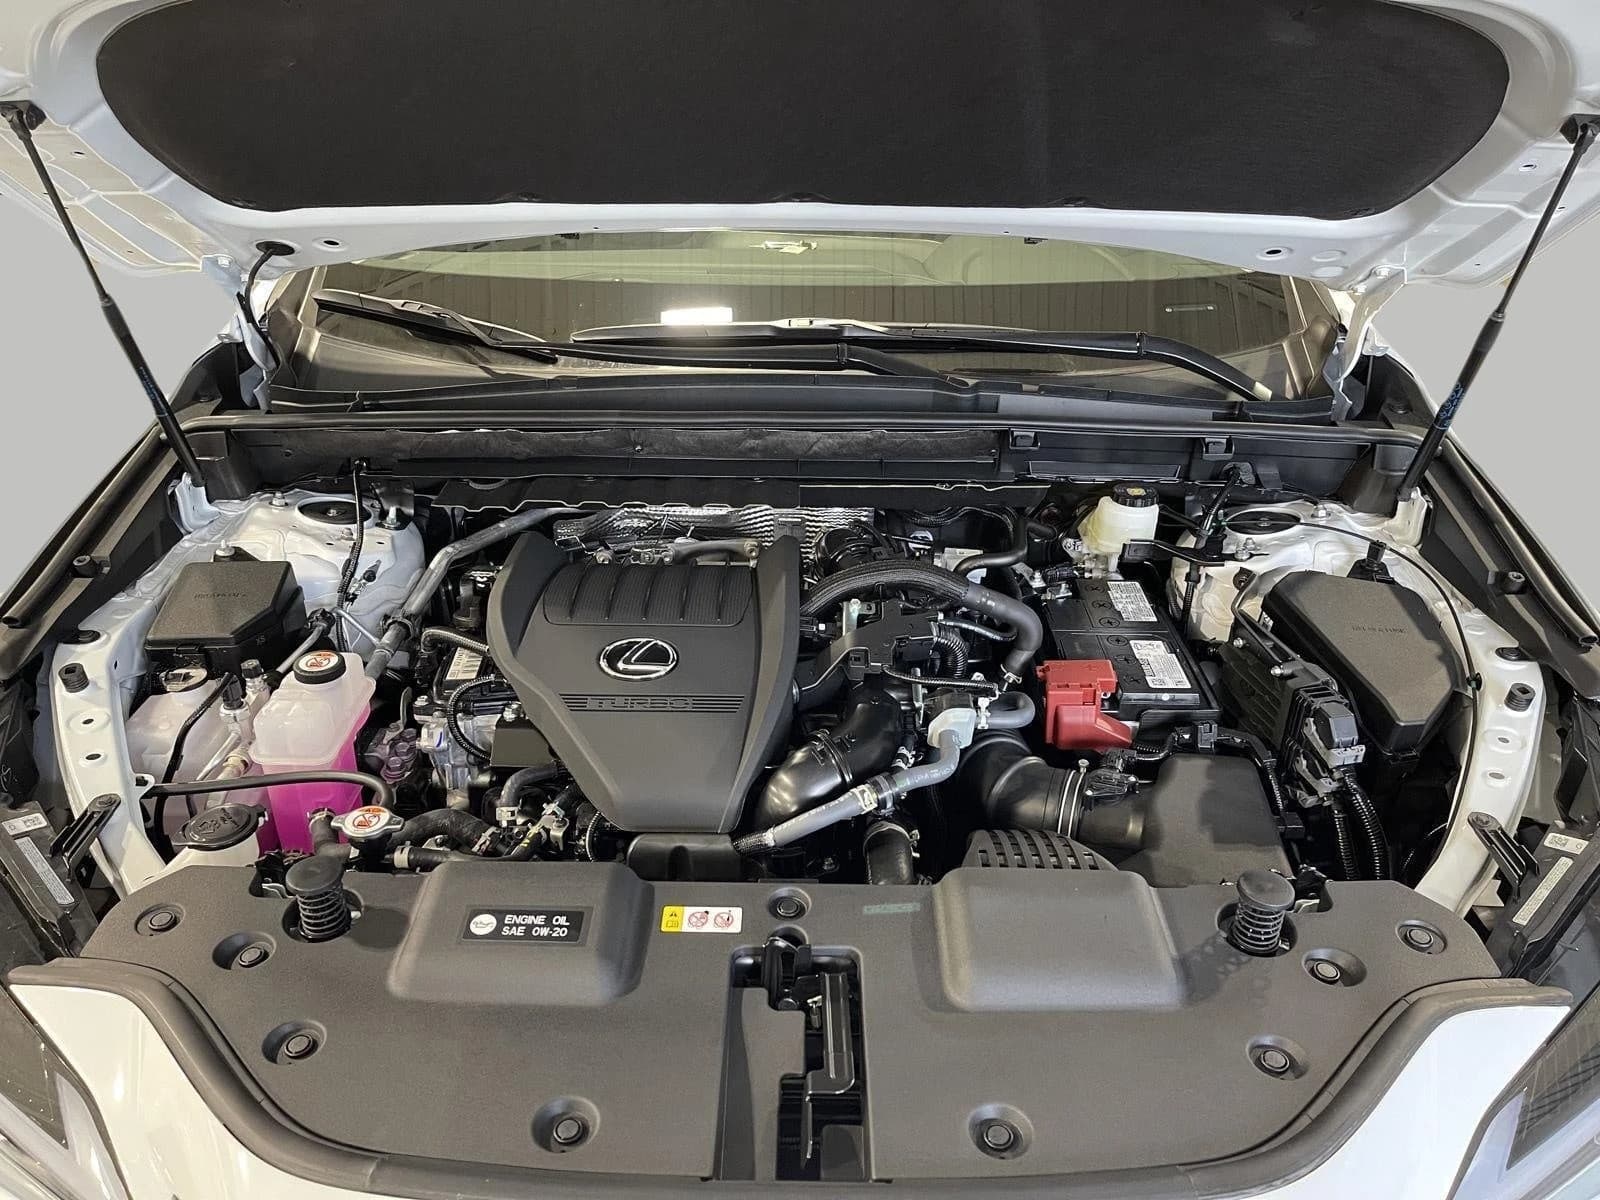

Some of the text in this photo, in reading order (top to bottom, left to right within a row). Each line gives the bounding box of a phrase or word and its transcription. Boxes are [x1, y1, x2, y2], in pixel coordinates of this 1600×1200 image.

[589, 698, 690, 708] TURBO
[504, 914, 570, 926] ENGINE OIL
[501, 926, 568, 937] SAE 0W-20
